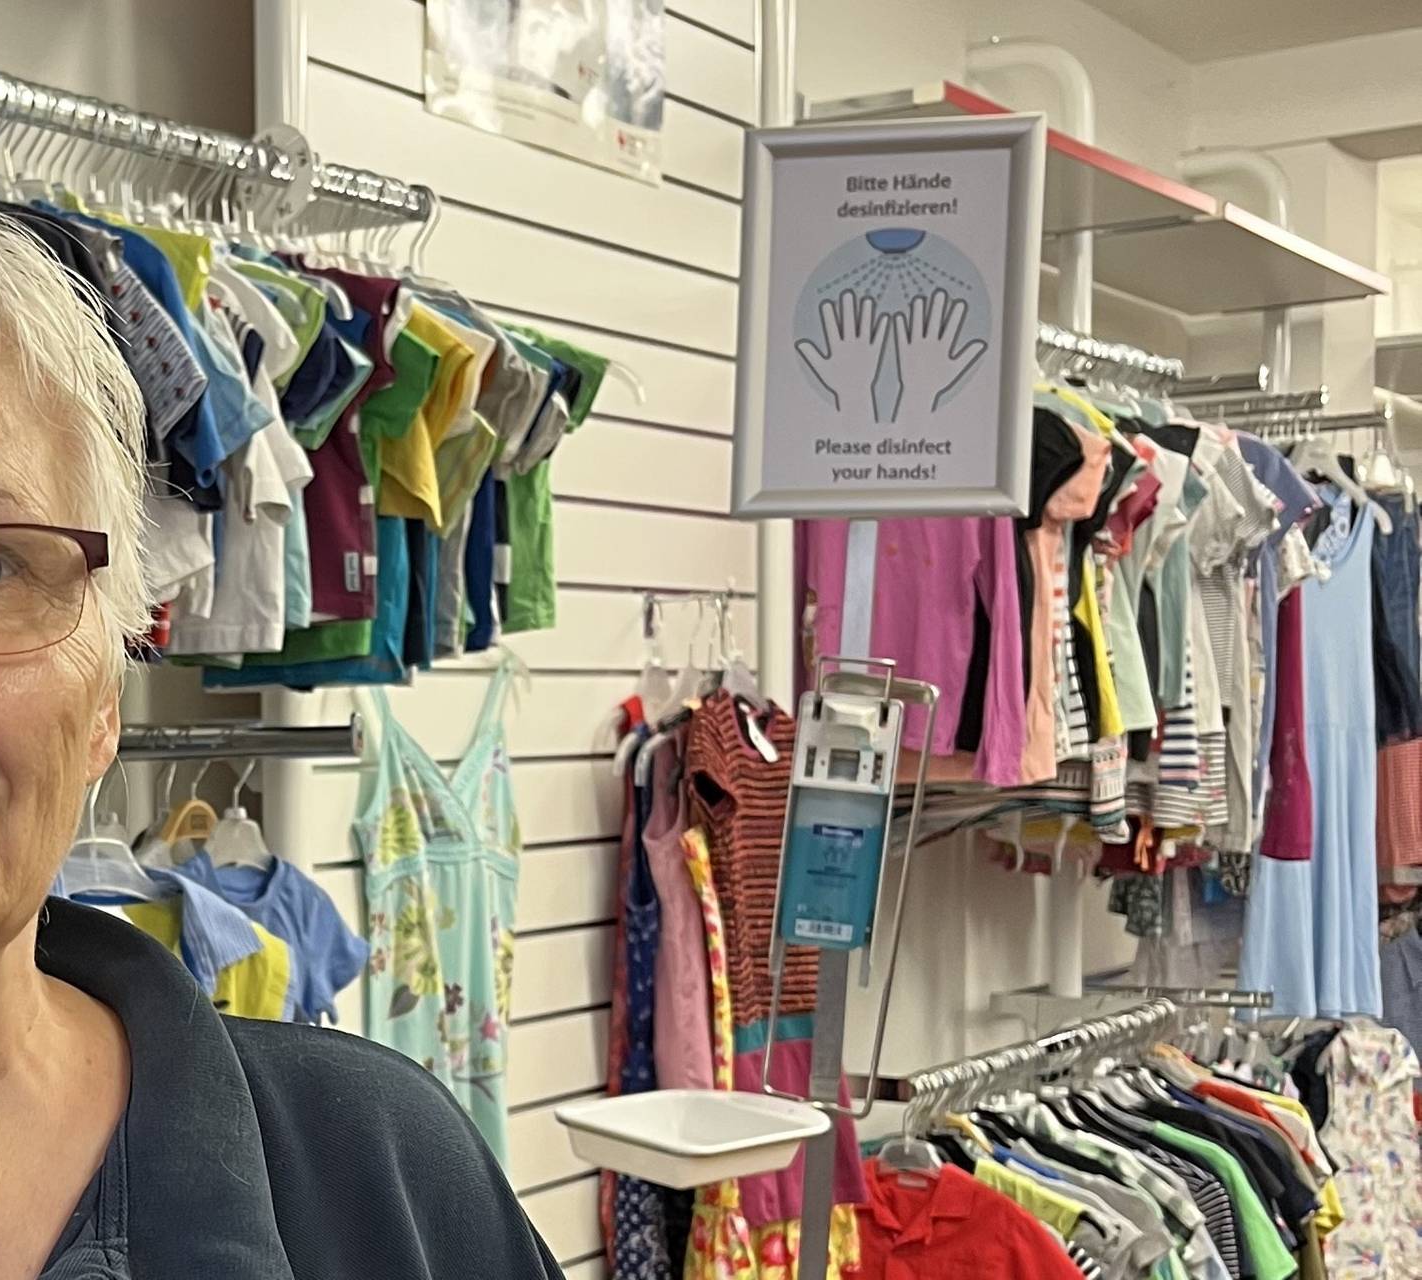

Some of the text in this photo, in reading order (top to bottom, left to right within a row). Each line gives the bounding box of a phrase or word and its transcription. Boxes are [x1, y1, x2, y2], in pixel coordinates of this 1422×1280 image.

[845, 172, 952, 193] Bitte Hände
[837, 198, 958, 218] desinfizieren!
[815, 438, 952, 455] Please disinfect
[831, 463, 936, 483] your hands!
